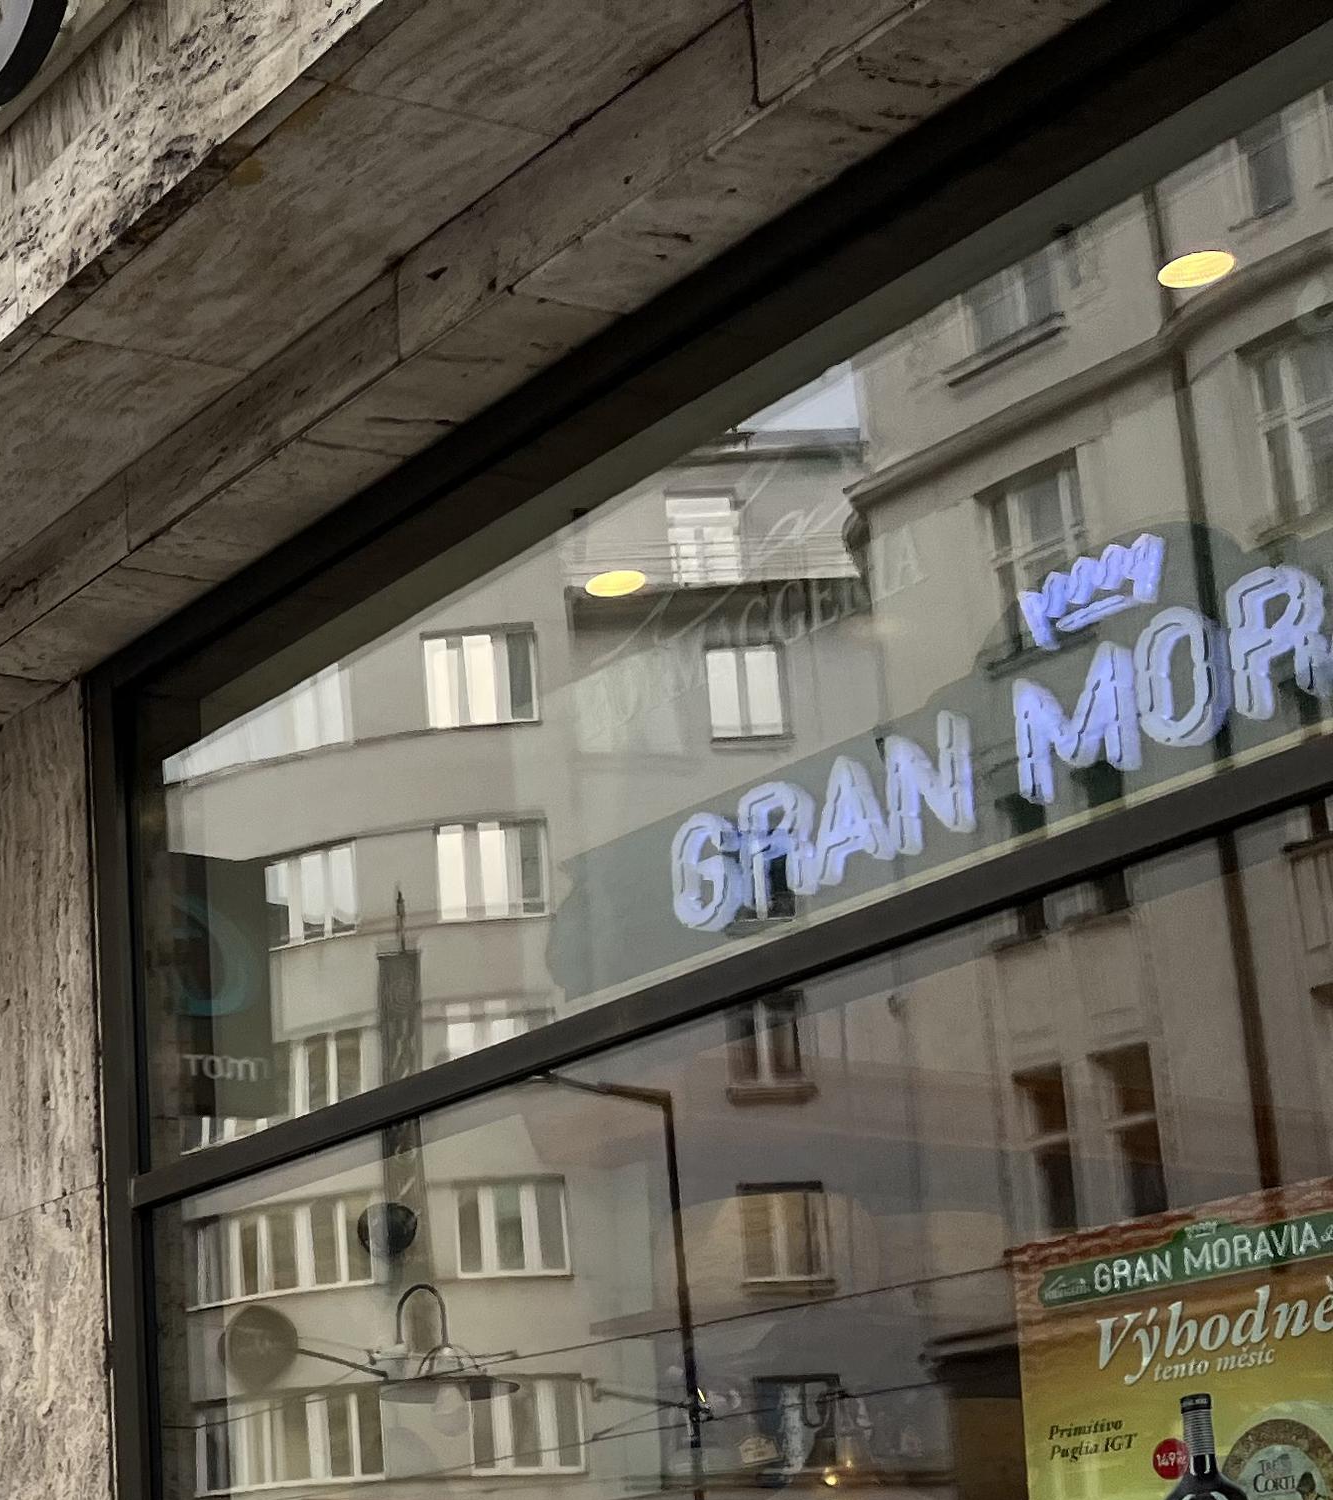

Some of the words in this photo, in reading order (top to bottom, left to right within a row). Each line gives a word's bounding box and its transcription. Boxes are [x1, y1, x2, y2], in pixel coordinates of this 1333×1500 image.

[670, 705, 976, 934] GRAN
[1093, 1251, 1174, 1294] GRAN
[1183, 1221, 1320, 1276] MORAVIA
[1153, 1358, 1210, 1382] tento
[1216, 1346, 1275, 1372] měsíc
[1048, 1418, 1123, 1441] Primitivo
[1050, 1440, 1100, 1462] Puglia
[1103, 1433, 1136, 1455] IGT
[1253, 1471, 1297, 1494] CORTI
